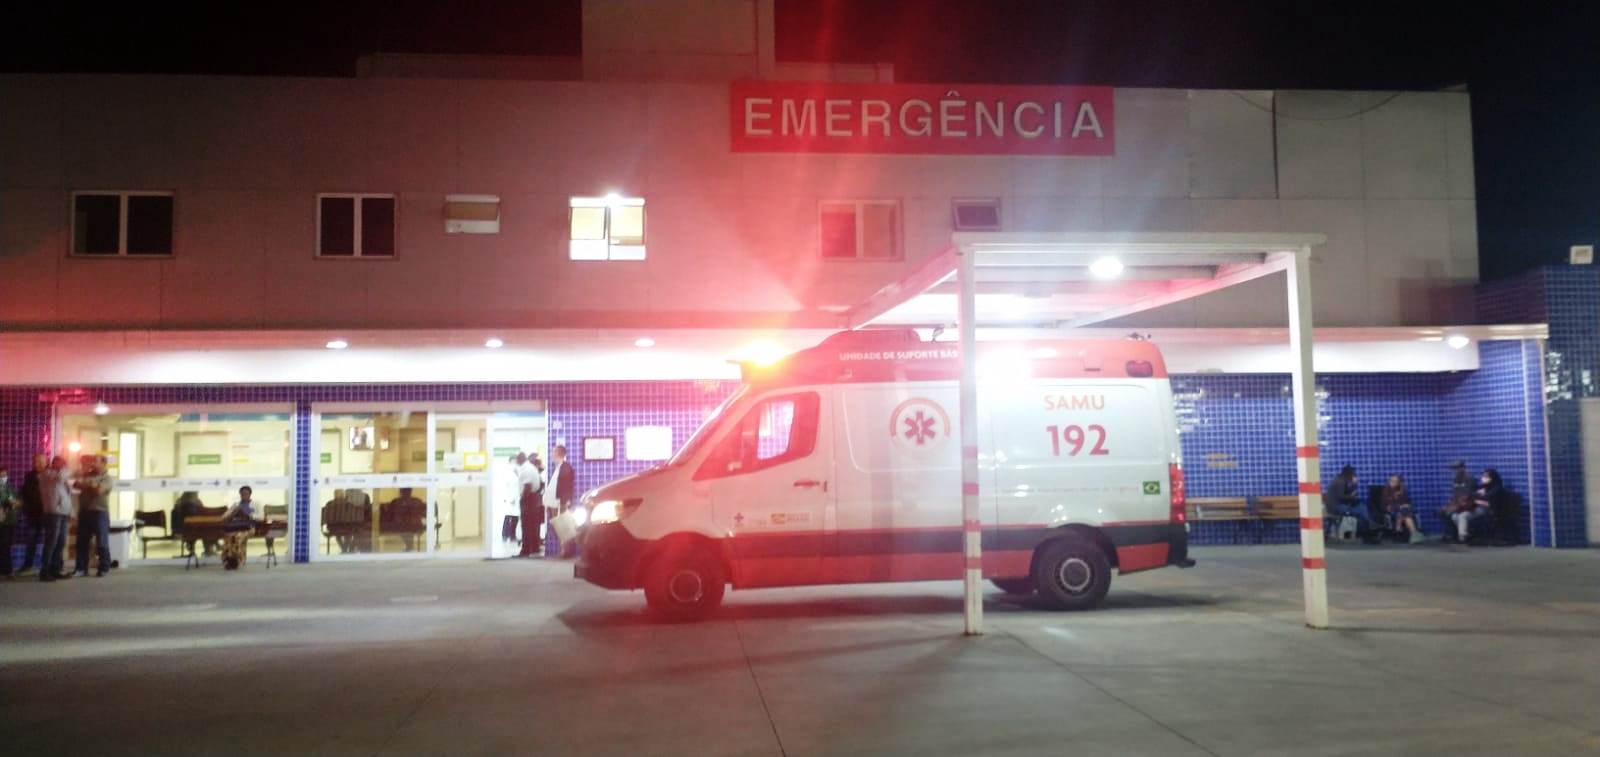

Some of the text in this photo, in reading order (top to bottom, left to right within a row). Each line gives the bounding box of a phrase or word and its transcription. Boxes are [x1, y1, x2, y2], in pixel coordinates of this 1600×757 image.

[744, 91, 1104, 139] EMERGÊNCIA
[839, 351, 881, 361] UNIDADE
[883, 351, 895, 361] DE
[897, 350, 938, 360] SUPORTE
[1044, 395, 1105, 411] SAMU
[1046, 424, 1109, 456] 192
